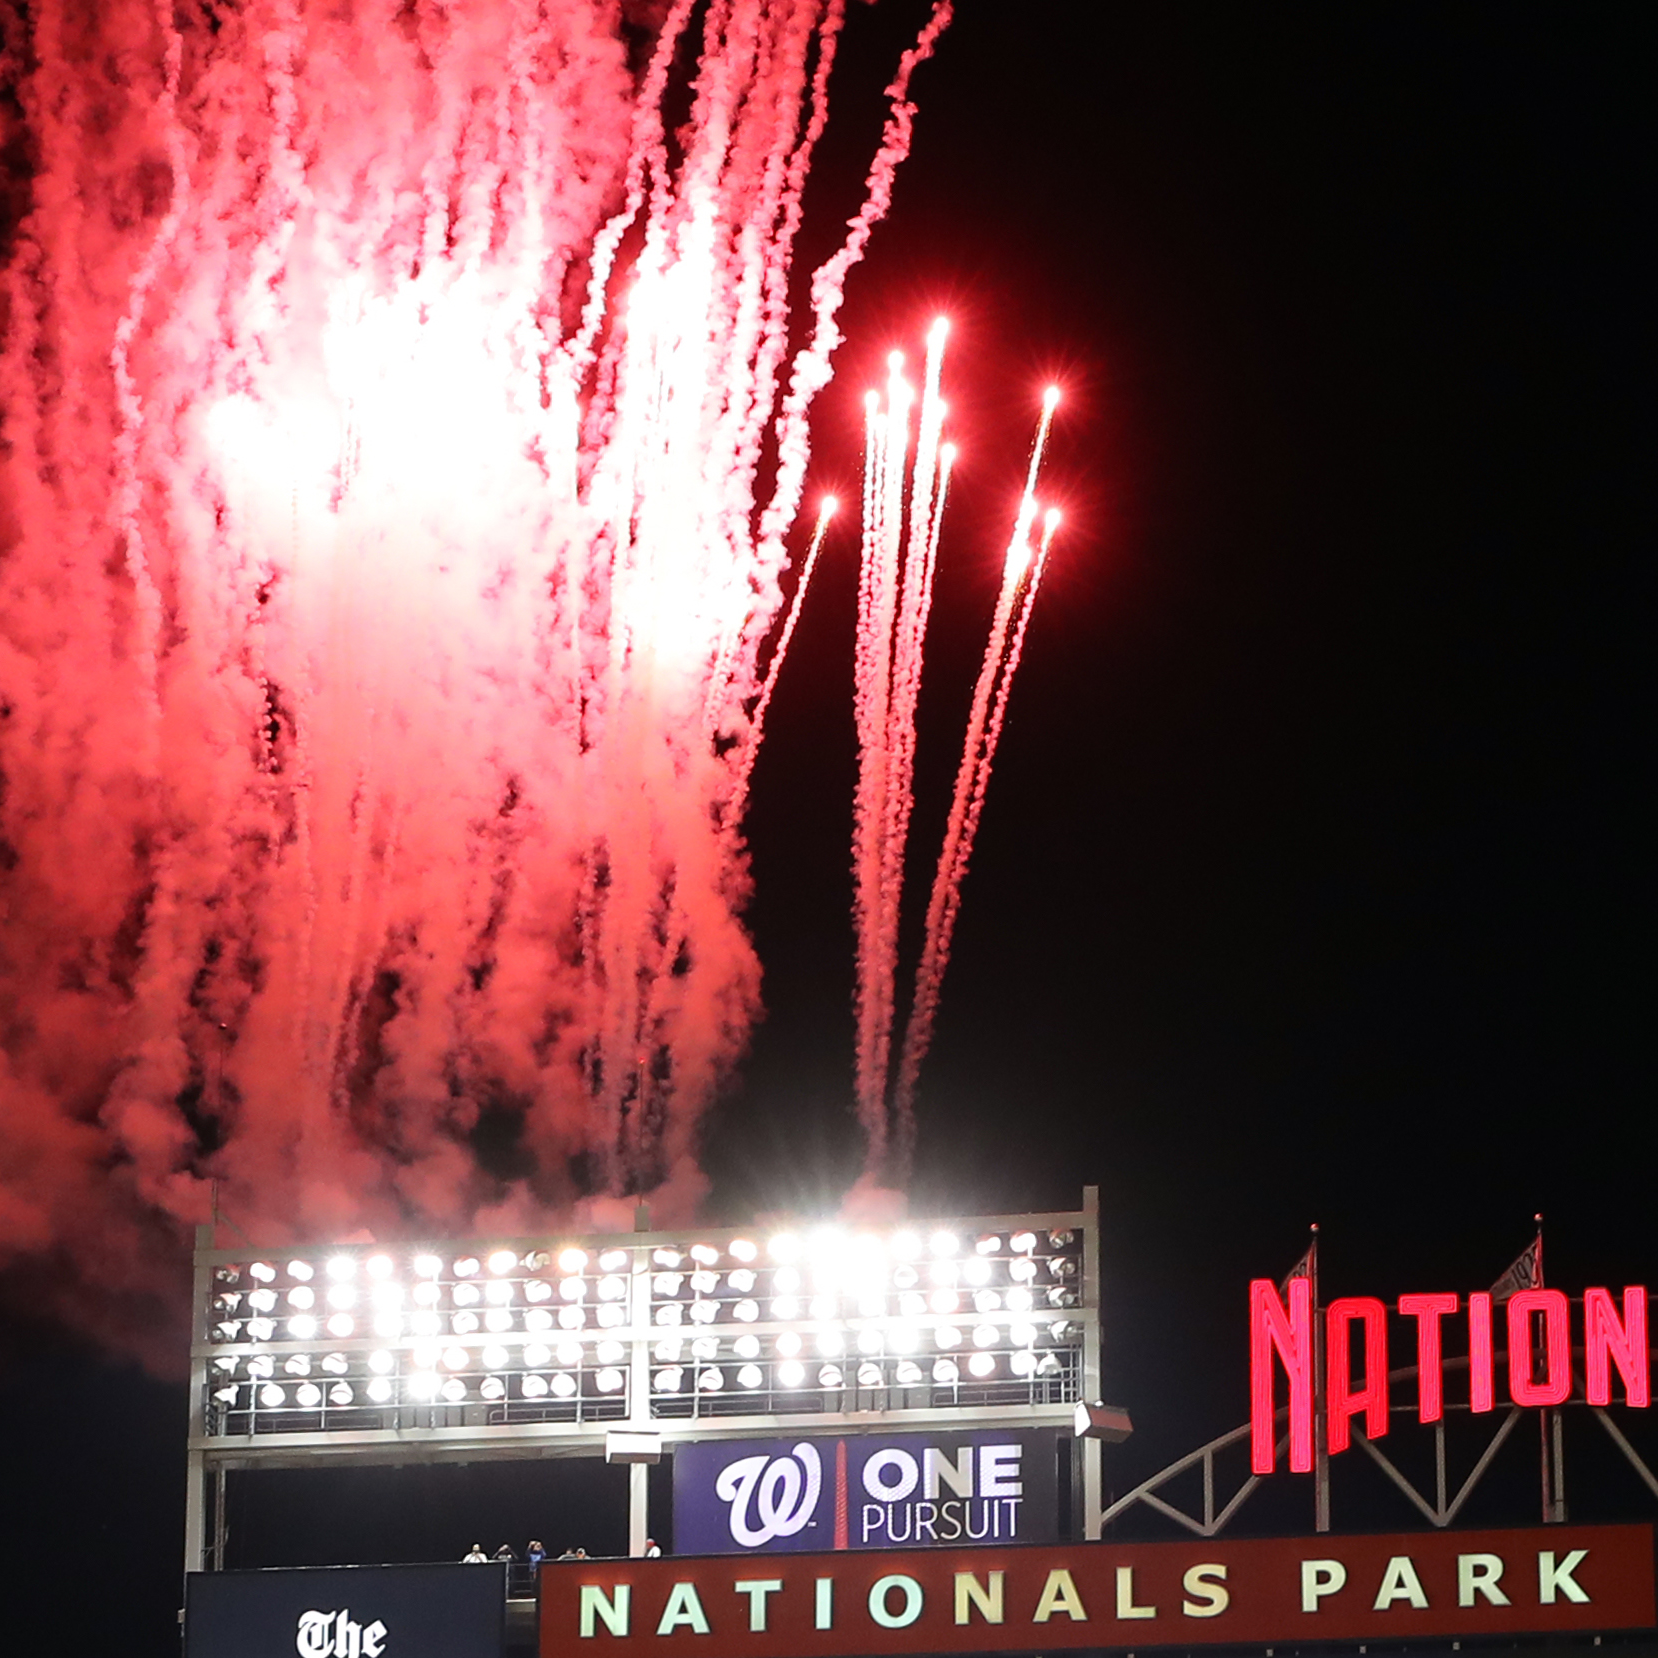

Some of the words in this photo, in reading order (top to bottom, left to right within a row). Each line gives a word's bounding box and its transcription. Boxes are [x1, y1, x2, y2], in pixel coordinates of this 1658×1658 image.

[862, 1444, 1023, 1501] ONE
[862, 1499, 1023, 1543] PURSUIT
[579, 1563, 1231, 1638] NATIONALS
[1300, 1550, 1591, 1613] PARK
